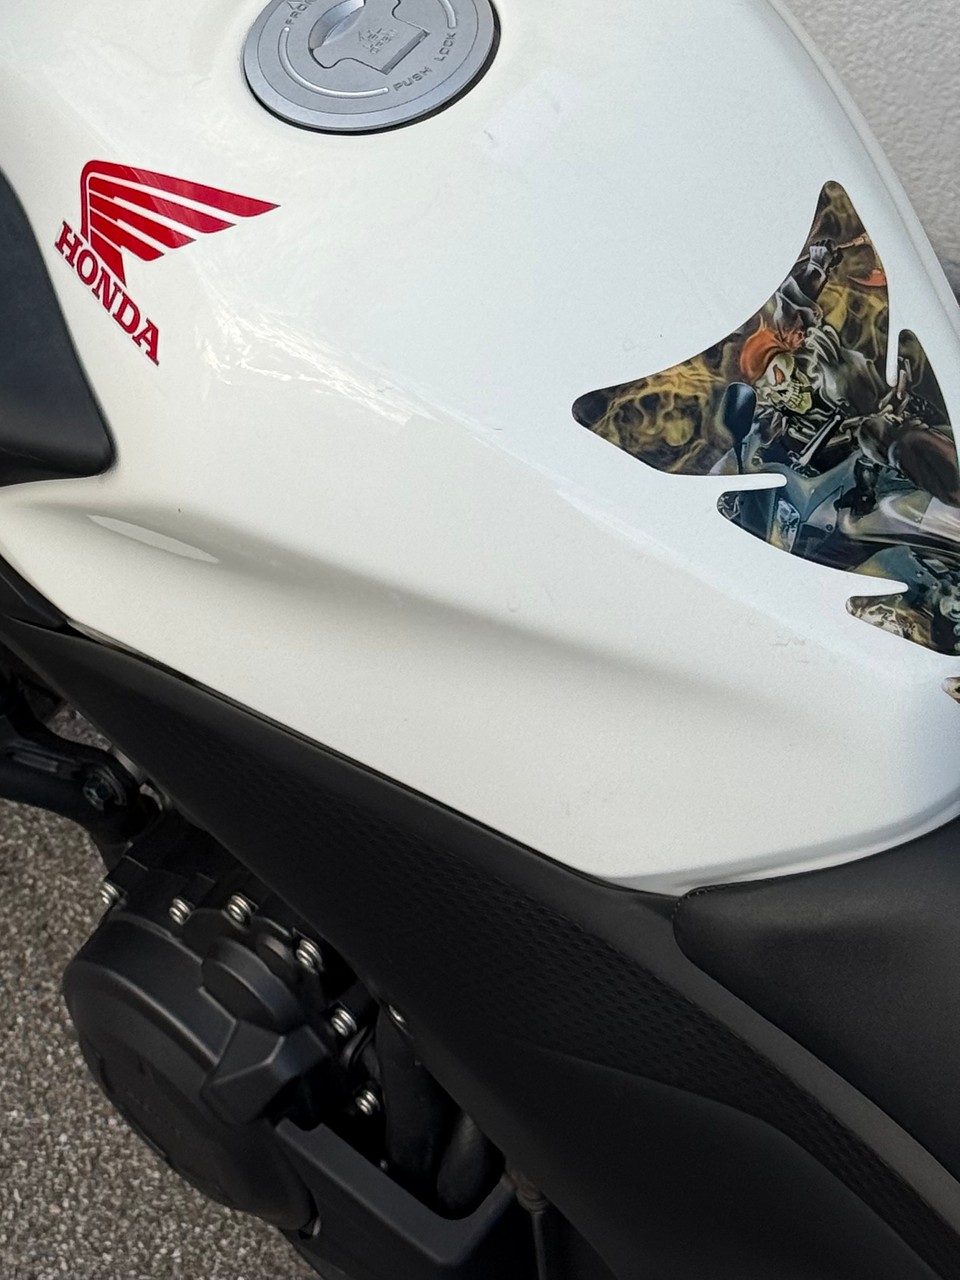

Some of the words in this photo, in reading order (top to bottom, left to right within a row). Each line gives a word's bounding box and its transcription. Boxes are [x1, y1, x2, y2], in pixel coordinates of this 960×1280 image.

[393, 66, 433, 92] PUSH
[434, 32, 457, 62] LOCK
[54, 220, 159, 366] HONDA
